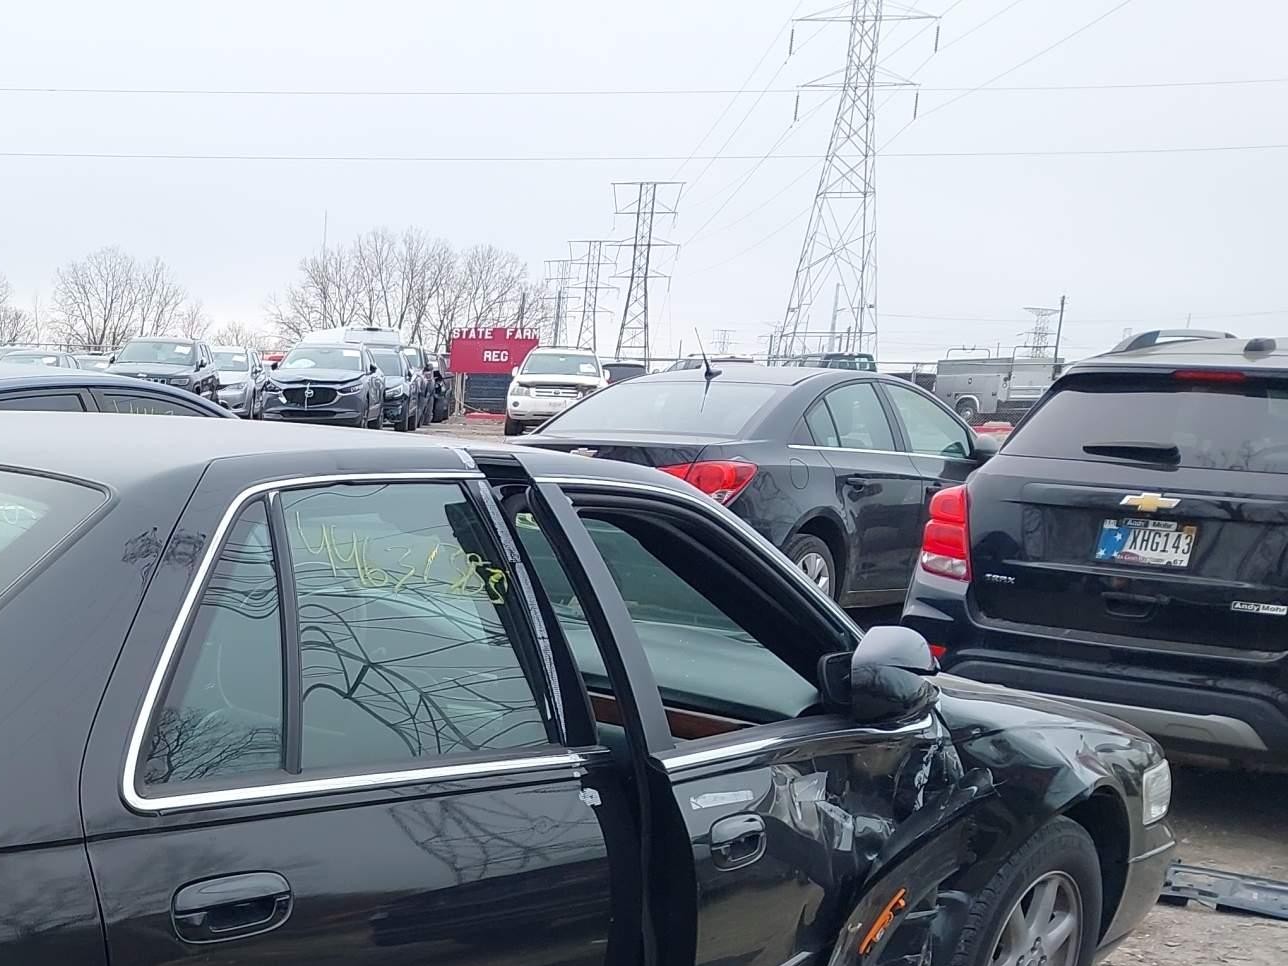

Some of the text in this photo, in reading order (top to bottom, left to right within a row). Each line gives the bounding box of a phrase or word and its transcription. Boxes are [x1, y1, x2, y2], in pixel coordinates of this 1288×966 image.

[452, 328, 540, 340] STATE FARM
[482, 350, 509, 362] REG
[1128, 529, 1193, 555] XHG143
[1233, 602, 1286, 613] Andy Mohr
